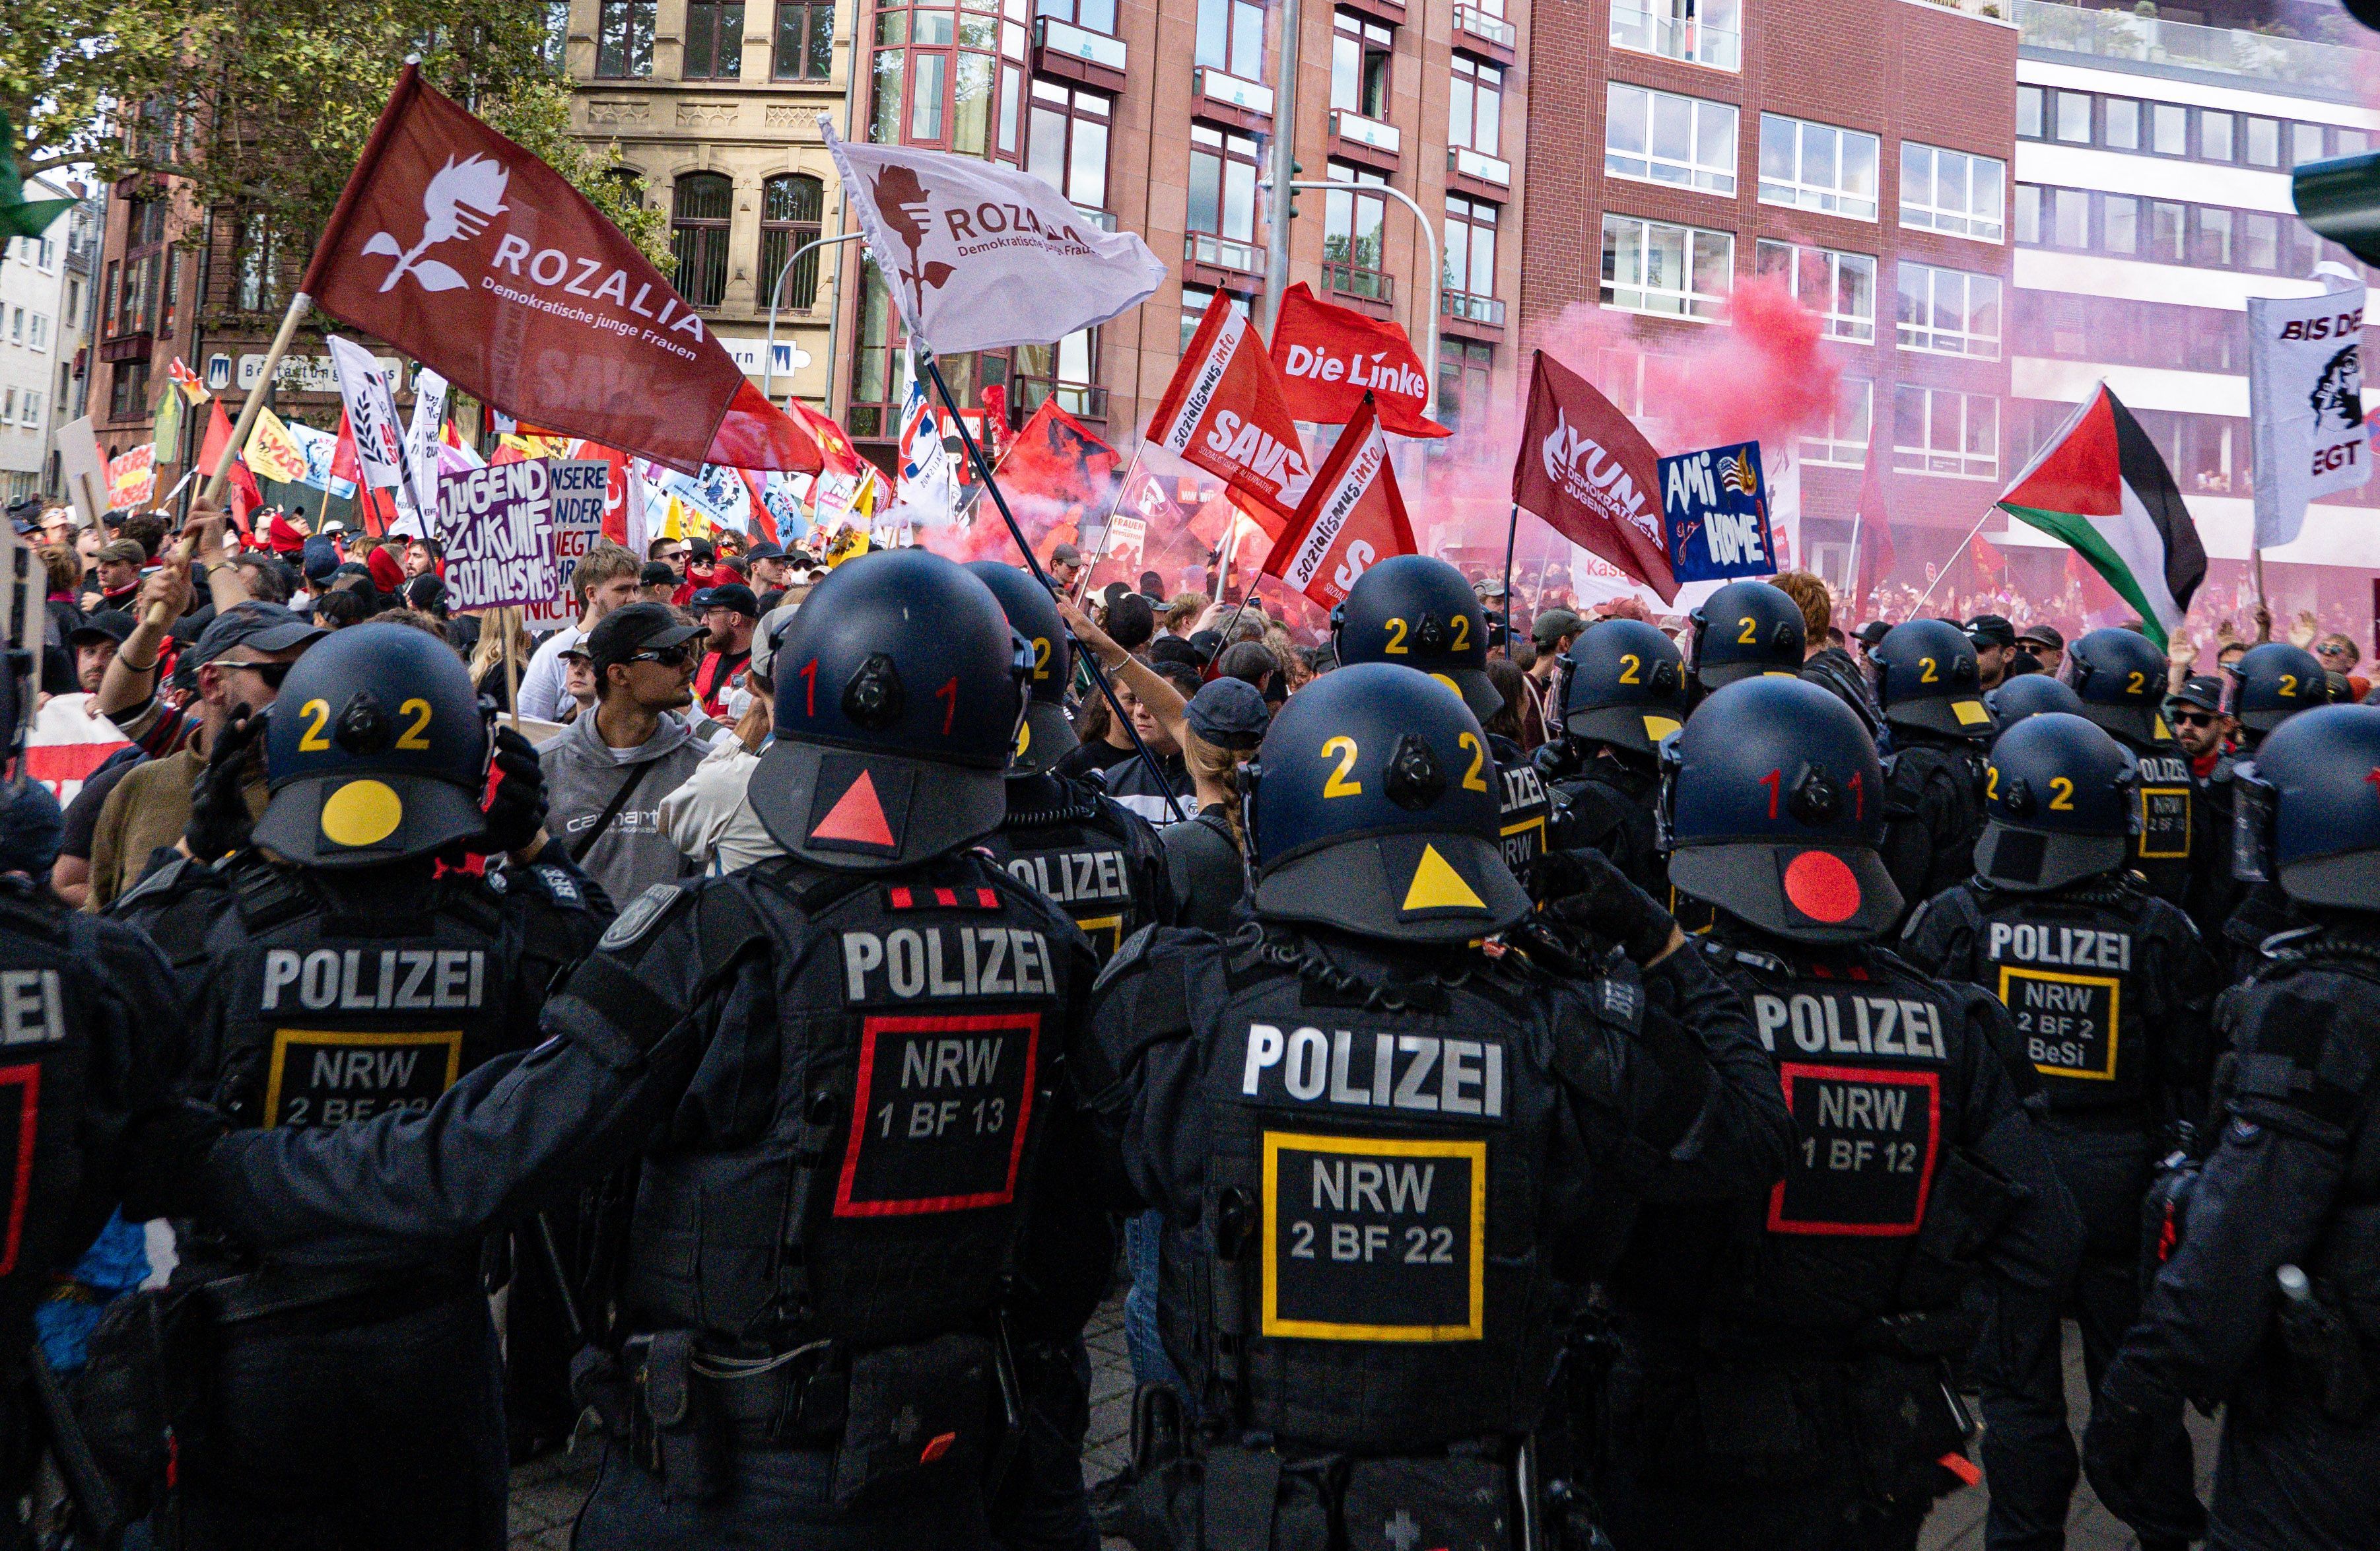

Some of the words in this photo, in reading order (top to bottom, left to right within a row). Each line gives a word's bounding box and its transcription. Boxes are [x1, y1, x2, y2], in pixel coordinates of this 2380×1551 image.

[957, 235, 1042, 257] Demokratische
[491, 233, 704, 343] ROZALIA
[481, 275, 594, 324] Demokratische
[594, 312, 638, 337] junge
[641, 329, 697, 362] Frauen
[2280, 317, 2332, 341] BIS
[1173, 333, 1236, 449] sozialismus.info
[1285, 343, 1347, 384] Die
[1345, 351, 1427, 399] Linke
[1207, 409, 1287, 478] SAV
[440, 460, 547, 528] JUGEND
[1198, 446, 1241, 475] SOZIALISTISCHE
[1239, 468, 1275, 496] ALTERNATIVE
[1567, 425, 1660, 536] YUNA
[1113, 516, 1145, 532] FRAUEN
[1297, 446, 1380, 584] sozialismus.info
[1564, 482, 1610, 520] JUGEND
[446, 499, 553, 566] ZUKUNFT
[444, 557, 556, 611] SOZIALISMUS
[1384, 617, 1408, 654] 2
[1450, 615, 1470, 651] 2
[1738, 617, 1757, 644] 2
[1031, 637, 1051, 680] 2
[1619, 654, 1641, 685] 2
[1919, 656, 1940, 683] 2
[2125, 671, 2145, 695] 2
[799, 658, 818, 718] 1
[935, 675, 957, 736] 1
[2278, 674, 2299, 698] 2
[298, 698, 331, 752] 2
[395, 698, 433, 750] 2
[1321, 735, 1363, 799] 2
[1458, 732, 1488, 793] 2
[1986, 766, 2000, 801] 2
[2049, 776, 2075, 811] 2
[2138, 758, 2192, 783] OLIZEI
[1759, 768, 1781, 821] 1
[1847, 771, 1864, 822] 1
[842, 927, 1056, 1002] POLIZEI
[1989, 922, 2131, 972] POLIZEI
[261, 948, 485, 1012] POLIZEI
[2024, 981, 2093, 1014] NRW
[1753, 993, 1947, 1059] POLIZEI
[2016, 1012, 2032, 1033] 2
[2039, 1014, 2074, 1037] BF
[2080, 1018, 2095, 1040] 2
[310, 1049, 420, 1090] NRW
[901, 1037, 1004, 1089] NRW
[1242, 1023, 1503, 1118] POLIZEI
[2027, 1037, 2085, 1067] BeSi
[285, 1095, 311, 1124] 2
[877, 1101, 895, 1139] 1
[908, 1100, 961, 1140] BF
[971, 1096, 1005, 1136] 13
[1818, 1084, 1907, 1132] NRW
[1802, 1136, 1816, 1169] 1
[1829, 1138, 1874, 1173] BF
[1885, 1141, 1917, 1173] 12
[1312, 1159, 1436, 1215] NRW
[1291, 1220, 1315, 1259] 2
[1331, 1222, 1390, 1263] BF
[1404, 1225, 1454, 1265] 22
